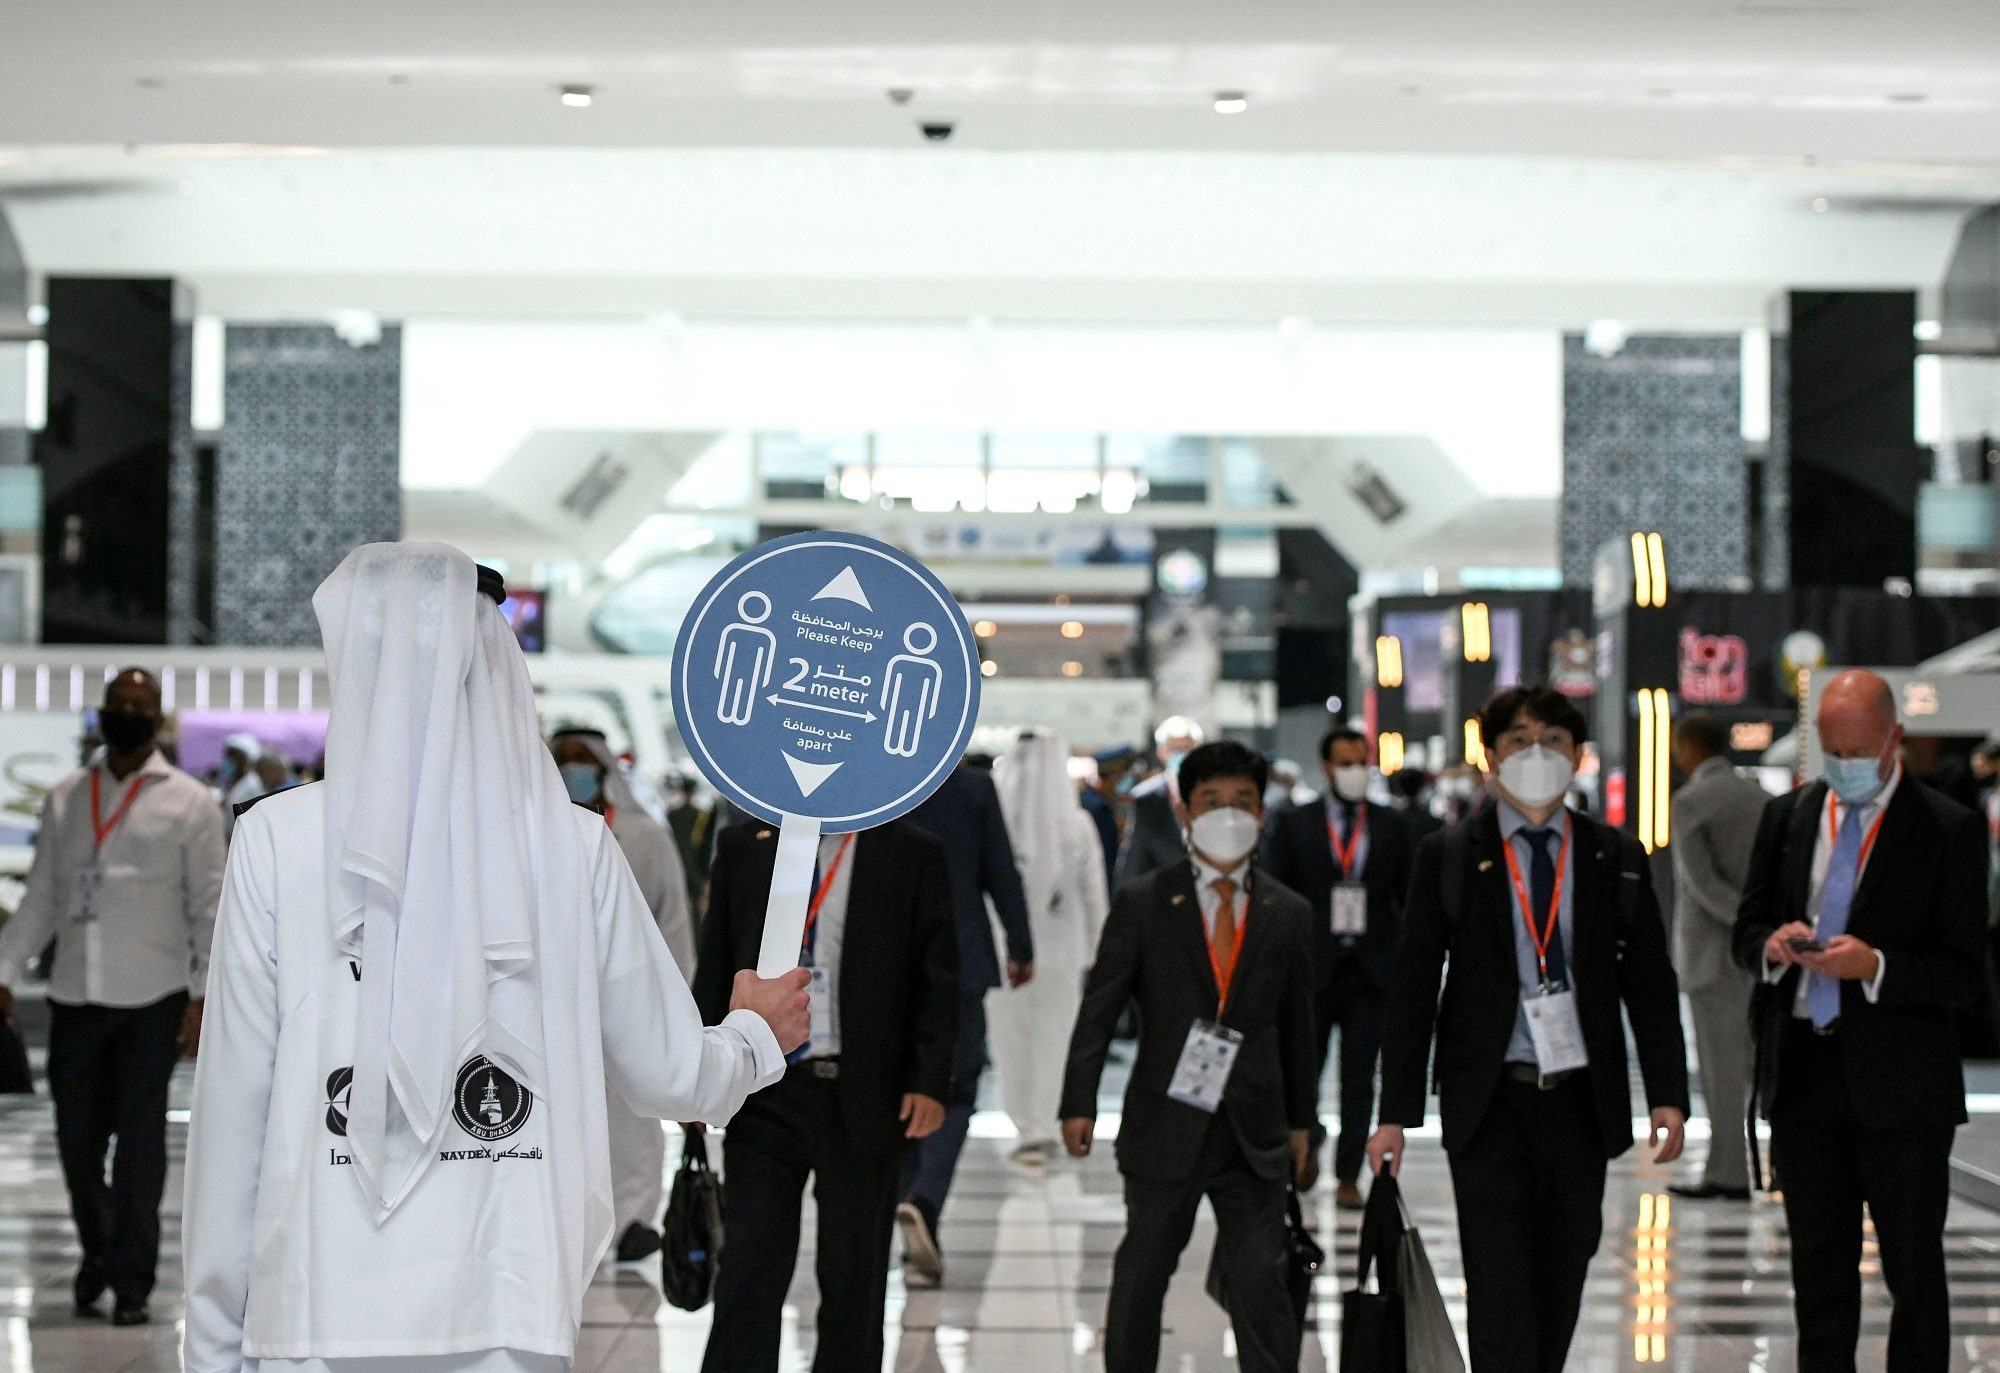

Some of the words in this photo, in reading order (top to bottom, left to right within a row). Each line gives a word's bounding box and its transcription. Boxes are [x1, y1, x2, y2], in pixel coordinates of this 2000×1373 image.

[791, 610, 851, 631] المحافظة
[796, 626, 838, 645] Please
[840, 634, 873, 653] Keep
[852, 626, 884, 640] يرجى
[782, 657, 810, 693] 2
[810, 682, 869, 704] meter
[812, 663, 872, 687] متر
[782, 717, 825, 736] مسافة
[826, 729, 852, 741] على
[796, 738, 833, 753] apart
[470, 1125, 487, 1137] ABU
[489, 1124, 513, 1138] DHABI
[439, 1143, 492, 1161] NAVDEX
